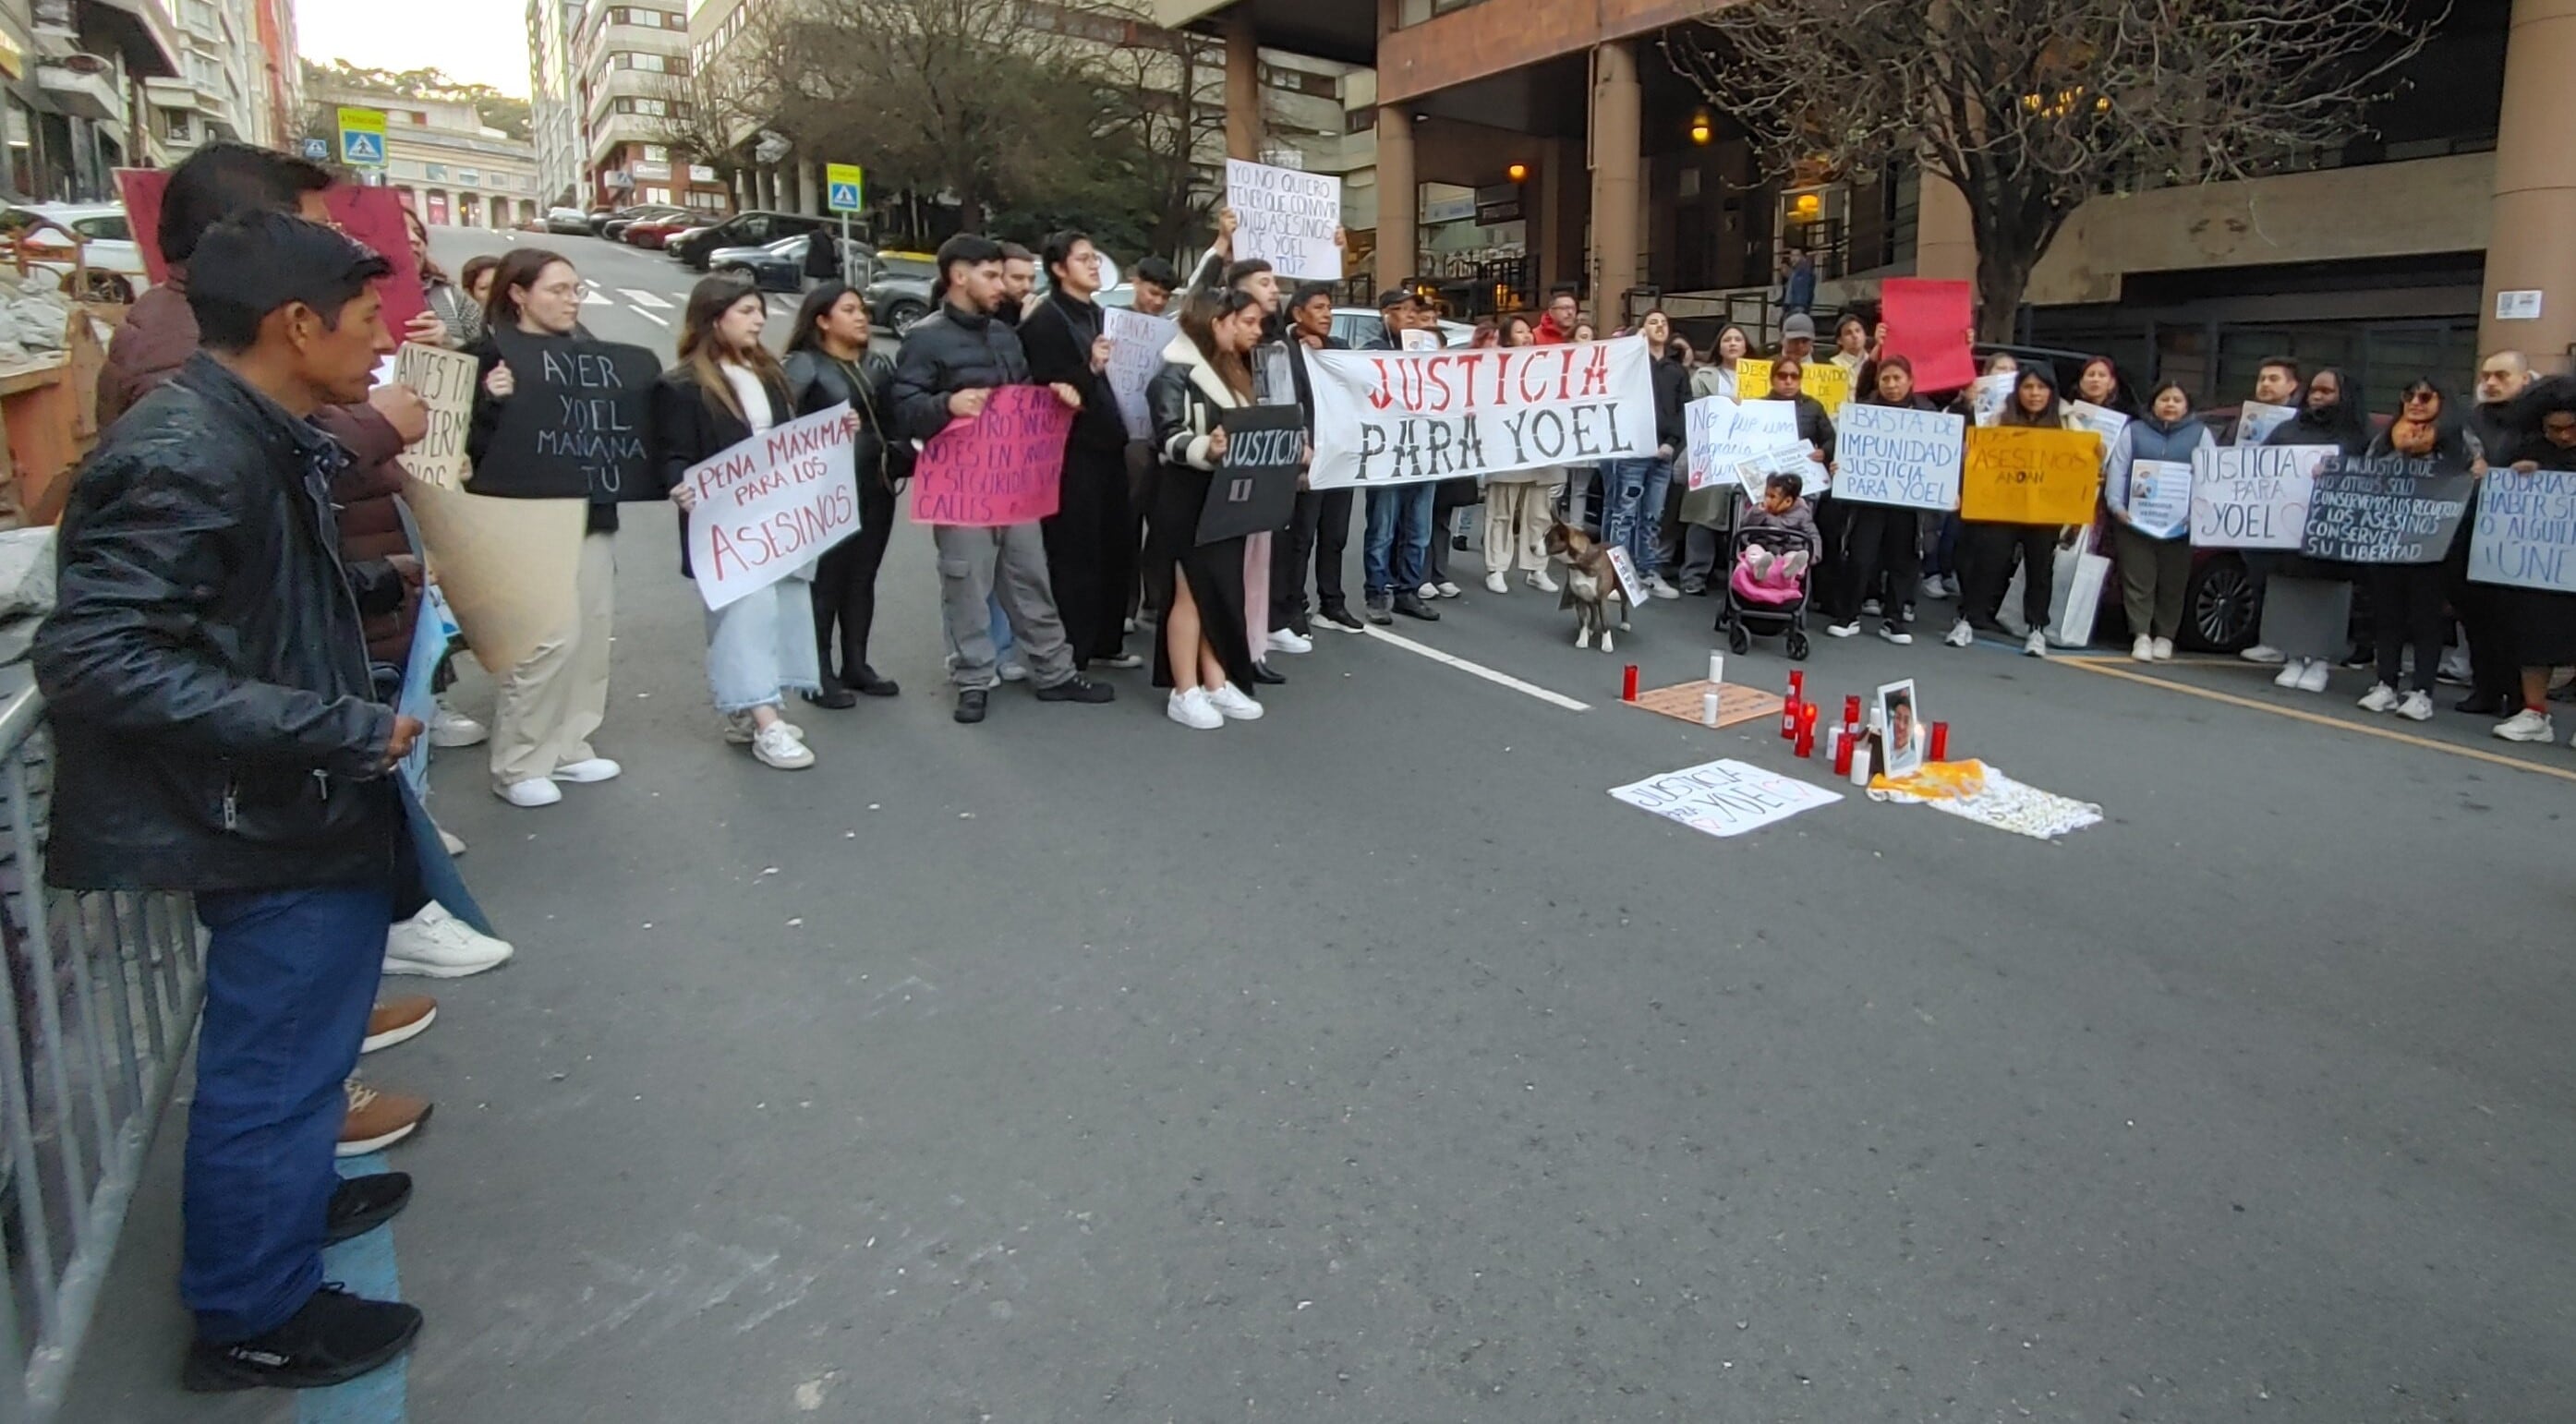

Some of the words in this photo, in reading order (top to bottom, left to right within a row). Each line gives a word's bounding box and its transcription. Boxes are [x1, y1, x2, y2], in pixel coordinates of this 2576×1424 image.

[1231, 163, 1251, 185] YO
[1255, 169, 1274, 190] NO
[1281, 174, 1330, 199] QUIERO
[1230, 185, 1263, 210] TENER
[1264, 191, 1286, 214] QUE
[1290, 194, 1337, 220] CONVIVIR
[1248, 211, 1266, 232] LOS
[1269, 213, 1333, 241] ASESINOS
[1248, 231, 1265, 254] DE
[1273, 235, 1307, 259] YOEL
[542, 349, 623, 389] AYER
[1368, 344, 1609, 412] JUSTICIA
[559, 393, 634, 432] YOEL
[1932, 412, 1959, 436] DE
[537, 428, 648, 461] MAÑANA
[1222, 428, 1304, 469] JUSTICIA
[1354, 410, 1486, 480] PARA
[1504, 402, 1633, 465] YOEL
[696, 453, 756, 501] PENA
[734, 470, 789, 507] PARA
[792, 455, 828, 484] LOS
[1842, 457, 1926, 483] JUSTICIA
[2194, 447, 2301, 486] JUSTICIA
[2345, 456, 2403, 475] INJUSTO
[2408, 460, 2436, 477] QUE
[1846, 477, 1889, 499] PARA
[1896, 479, 1951, 506] YOEL
[2232, 479, 2285, 501] PARA
[2479, 490, 2547, 518] HABER
[710, 484, 853, 582] ASESINOS
[2201, 501, 2277, 539] YOEL
[2305, 518, 2401, 547] CONSERVEN
[2326, 508, 2354, 525] LOS
[2359, 510, 2440, 536] ASESINOS
[2480, 516, 2496, 536] O
[2306, 537, 2334, 555] SU
[2340, 543, 2423, 562] LIBERTAD
[1630, 766, 1744, 807] JUSTICIA
[1690, 782, 1804, 824] YOEL
